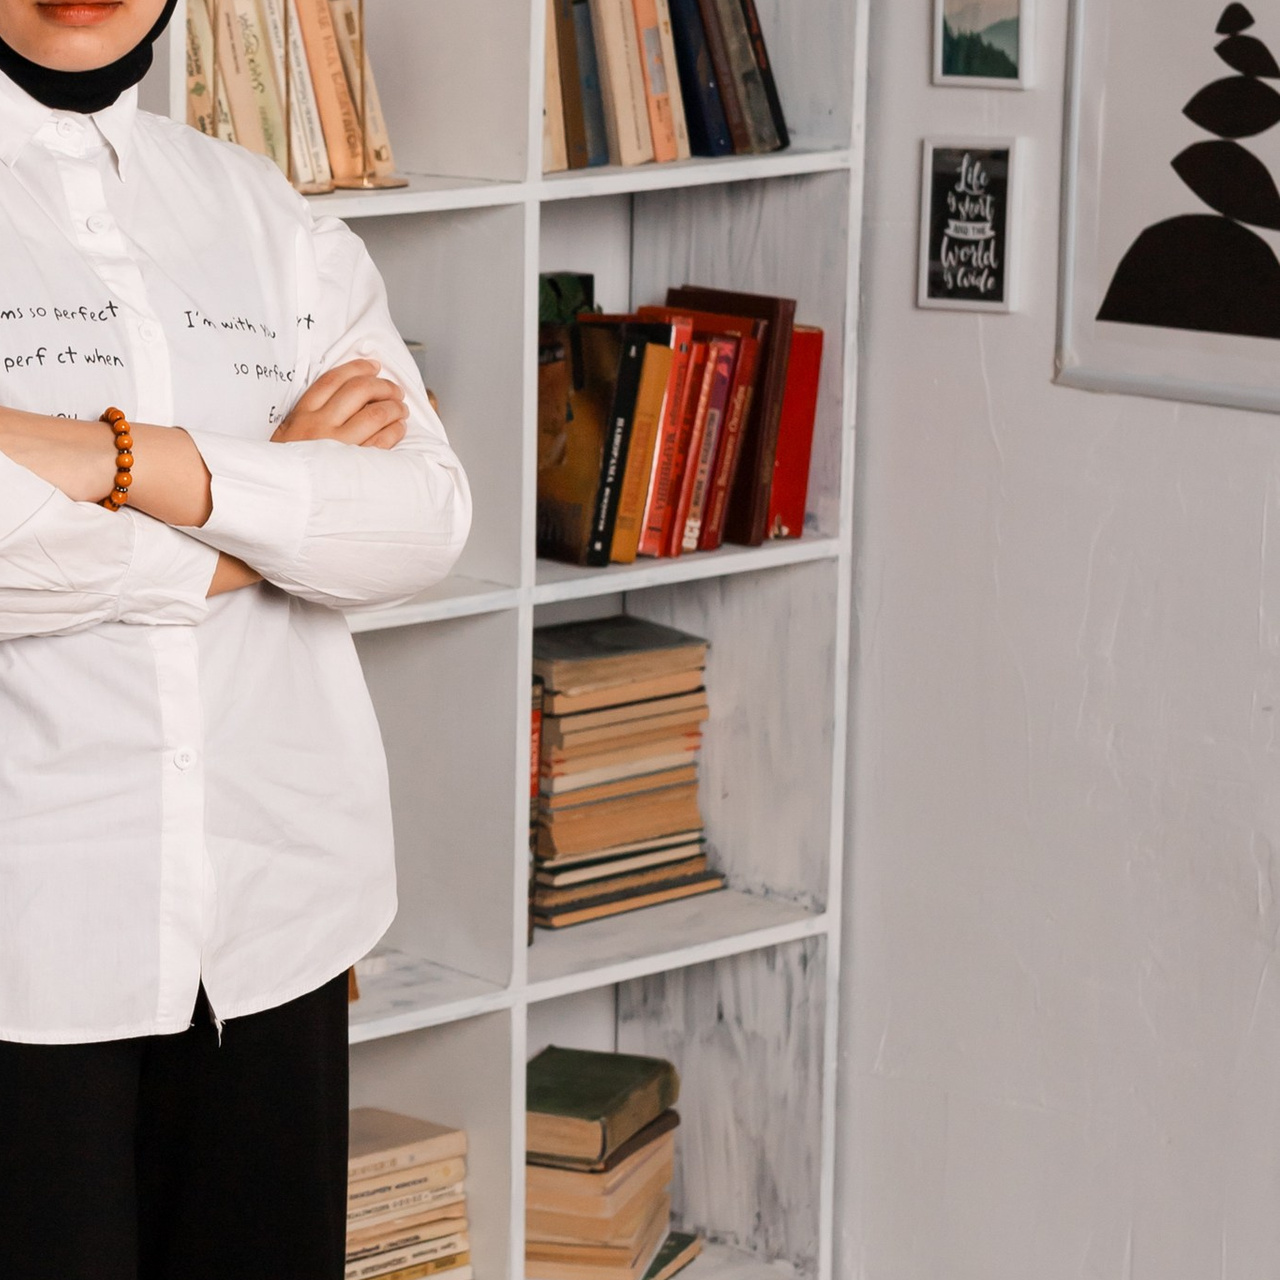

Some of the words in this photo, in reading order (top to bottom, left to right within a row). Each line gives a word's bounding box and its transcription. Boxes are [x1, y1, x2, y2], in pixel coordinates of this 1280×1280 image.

[954, 152, 989, 195] Life
[958, 194, 995, 222] short
[953, 223, 969, 235] AND
[971, 224, 987, 235] THE
[30, 306, 48, 319] so
[53, 300, 119, 322] perfect
[184, 310, 217, 329] I'm
[221, 317, 257, 333] with
[84, 348, 125, 368] when
[233, 363, 250, 375] so
[255, 363, 297, 382] perfec
